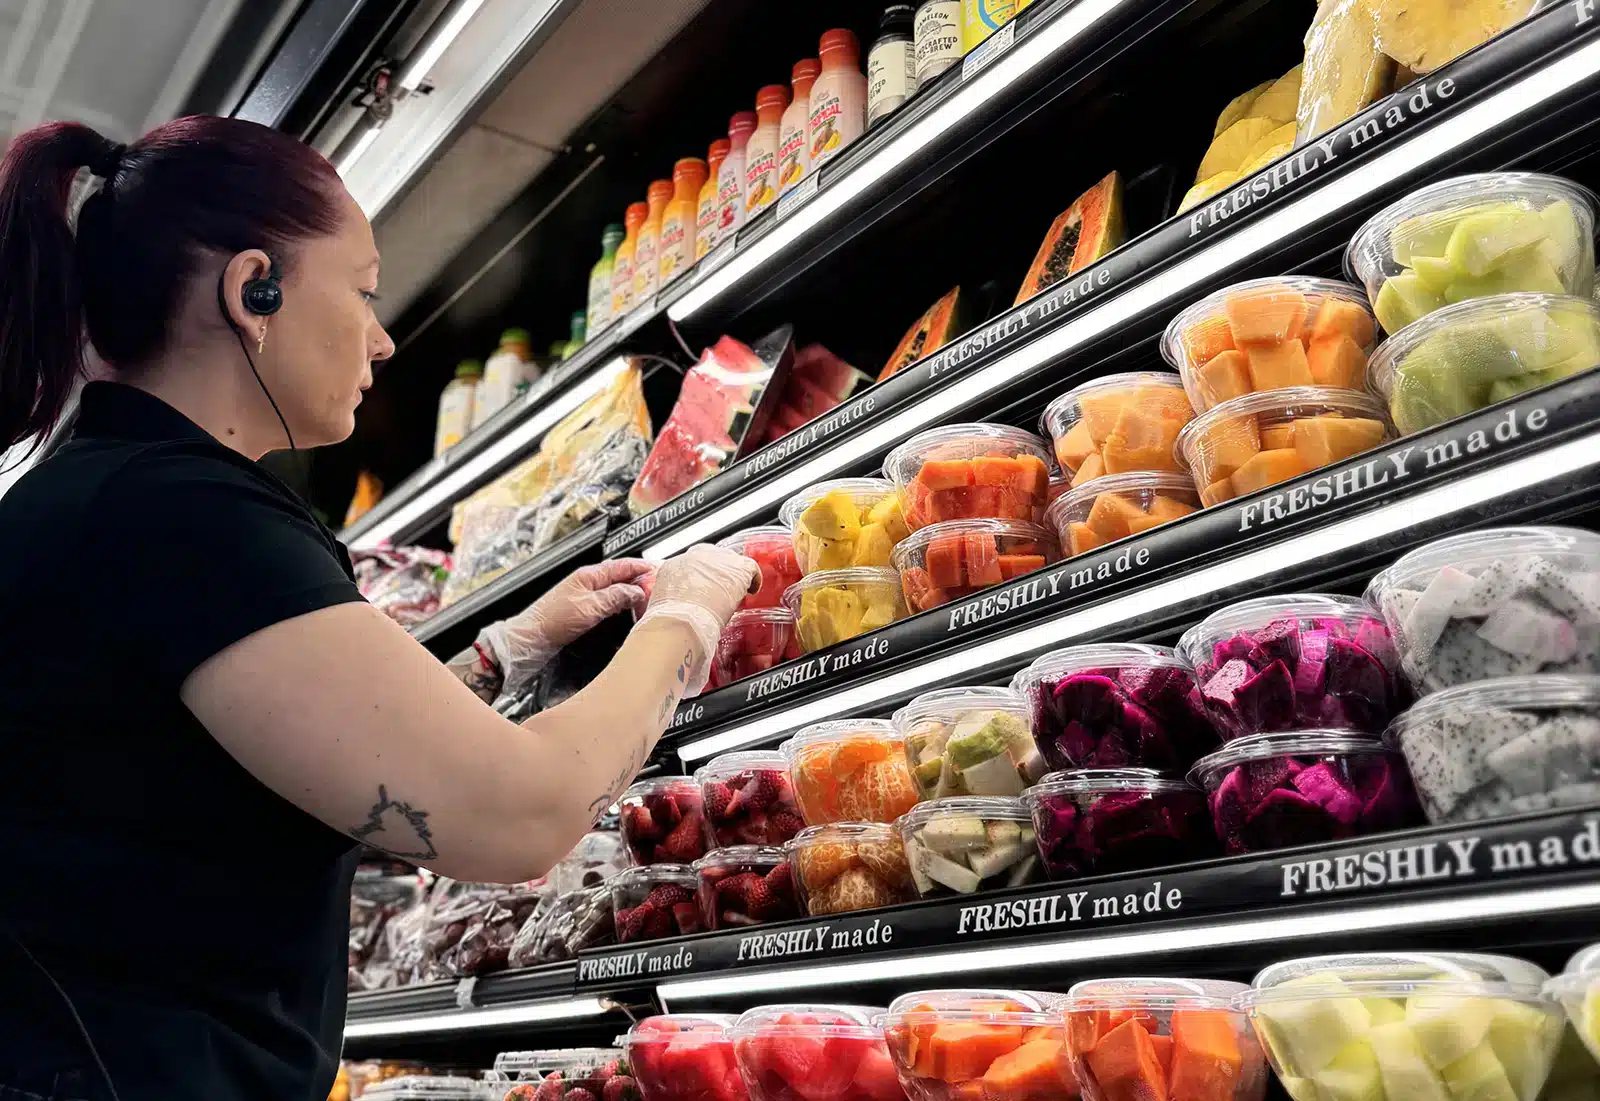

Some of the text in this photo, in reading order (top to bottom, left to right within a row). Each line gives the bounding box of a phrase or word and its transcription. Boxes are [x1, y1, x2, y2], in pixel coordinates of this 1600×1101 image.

[1188, 78, 1456, 238] FRESHLY made
[928, 268, 1111, 379] FRESHLY made
[743, 396, 876, 479] FRESHLY made
[1238, 404, 1549, 533] FRESHLY made
[602, 491, 705, 556] FRESHLY made
[947, 546, 1150, 632] FRESHLY made
[745, 637, 889, 702] FRESHLY made
[1280, 819, 1600, 897] FRESHLY mad
[737, 918, 893, 962] FRESHLY made
[956, 881, 1183, 935] FRESHLY made
[578, 946, 693, 981] FRESHLY made
